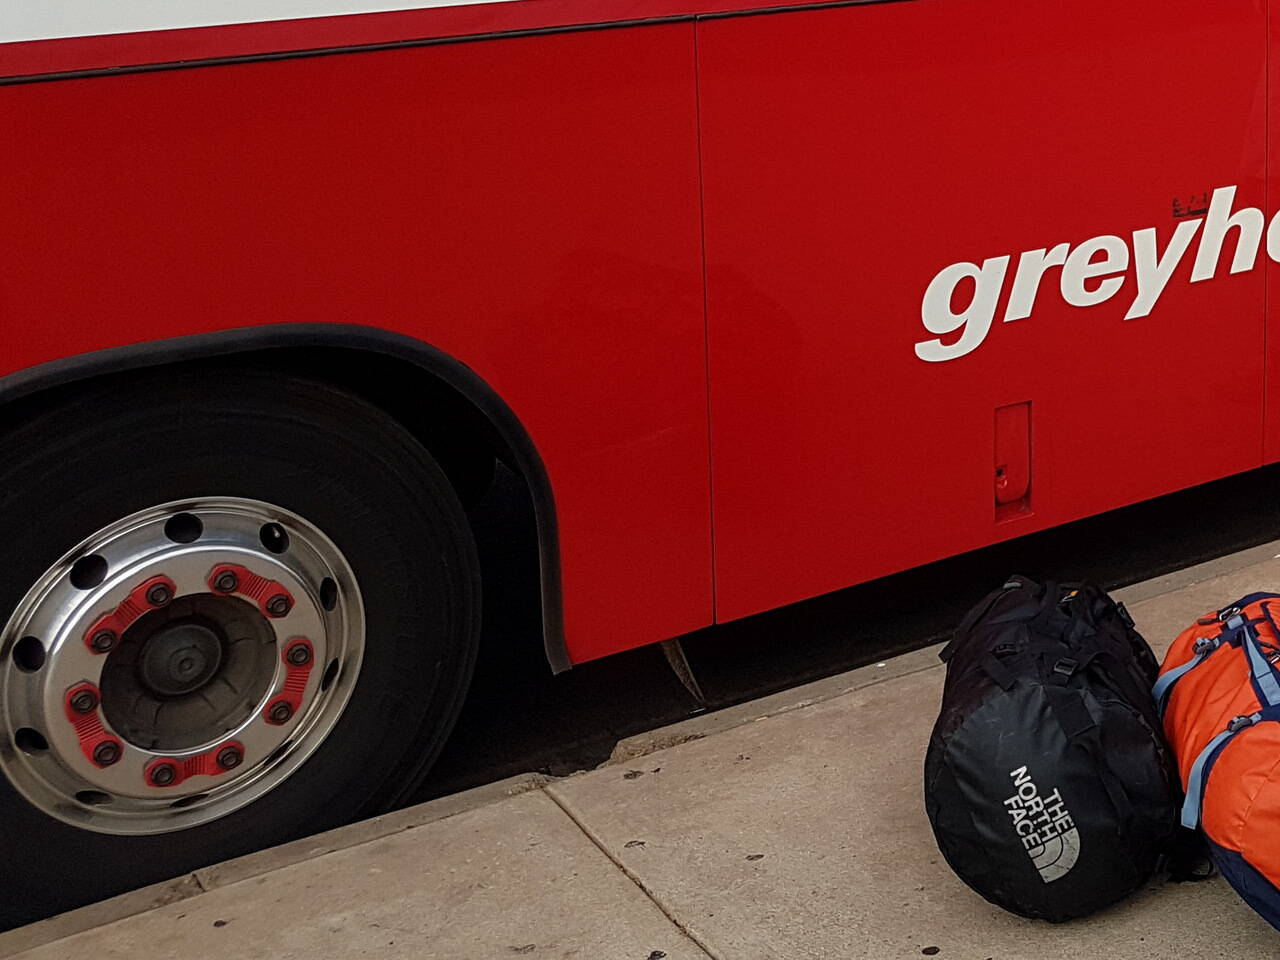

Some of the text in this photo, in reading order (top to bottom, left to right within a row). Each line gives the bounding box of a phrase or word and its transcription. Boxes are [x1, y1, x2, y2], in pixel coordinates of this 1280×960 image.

[1003, 794, 1042, 850] FACE
[1009, 765, 1059, 842] NORTH
[1043, 787, 1075, 834] THE
